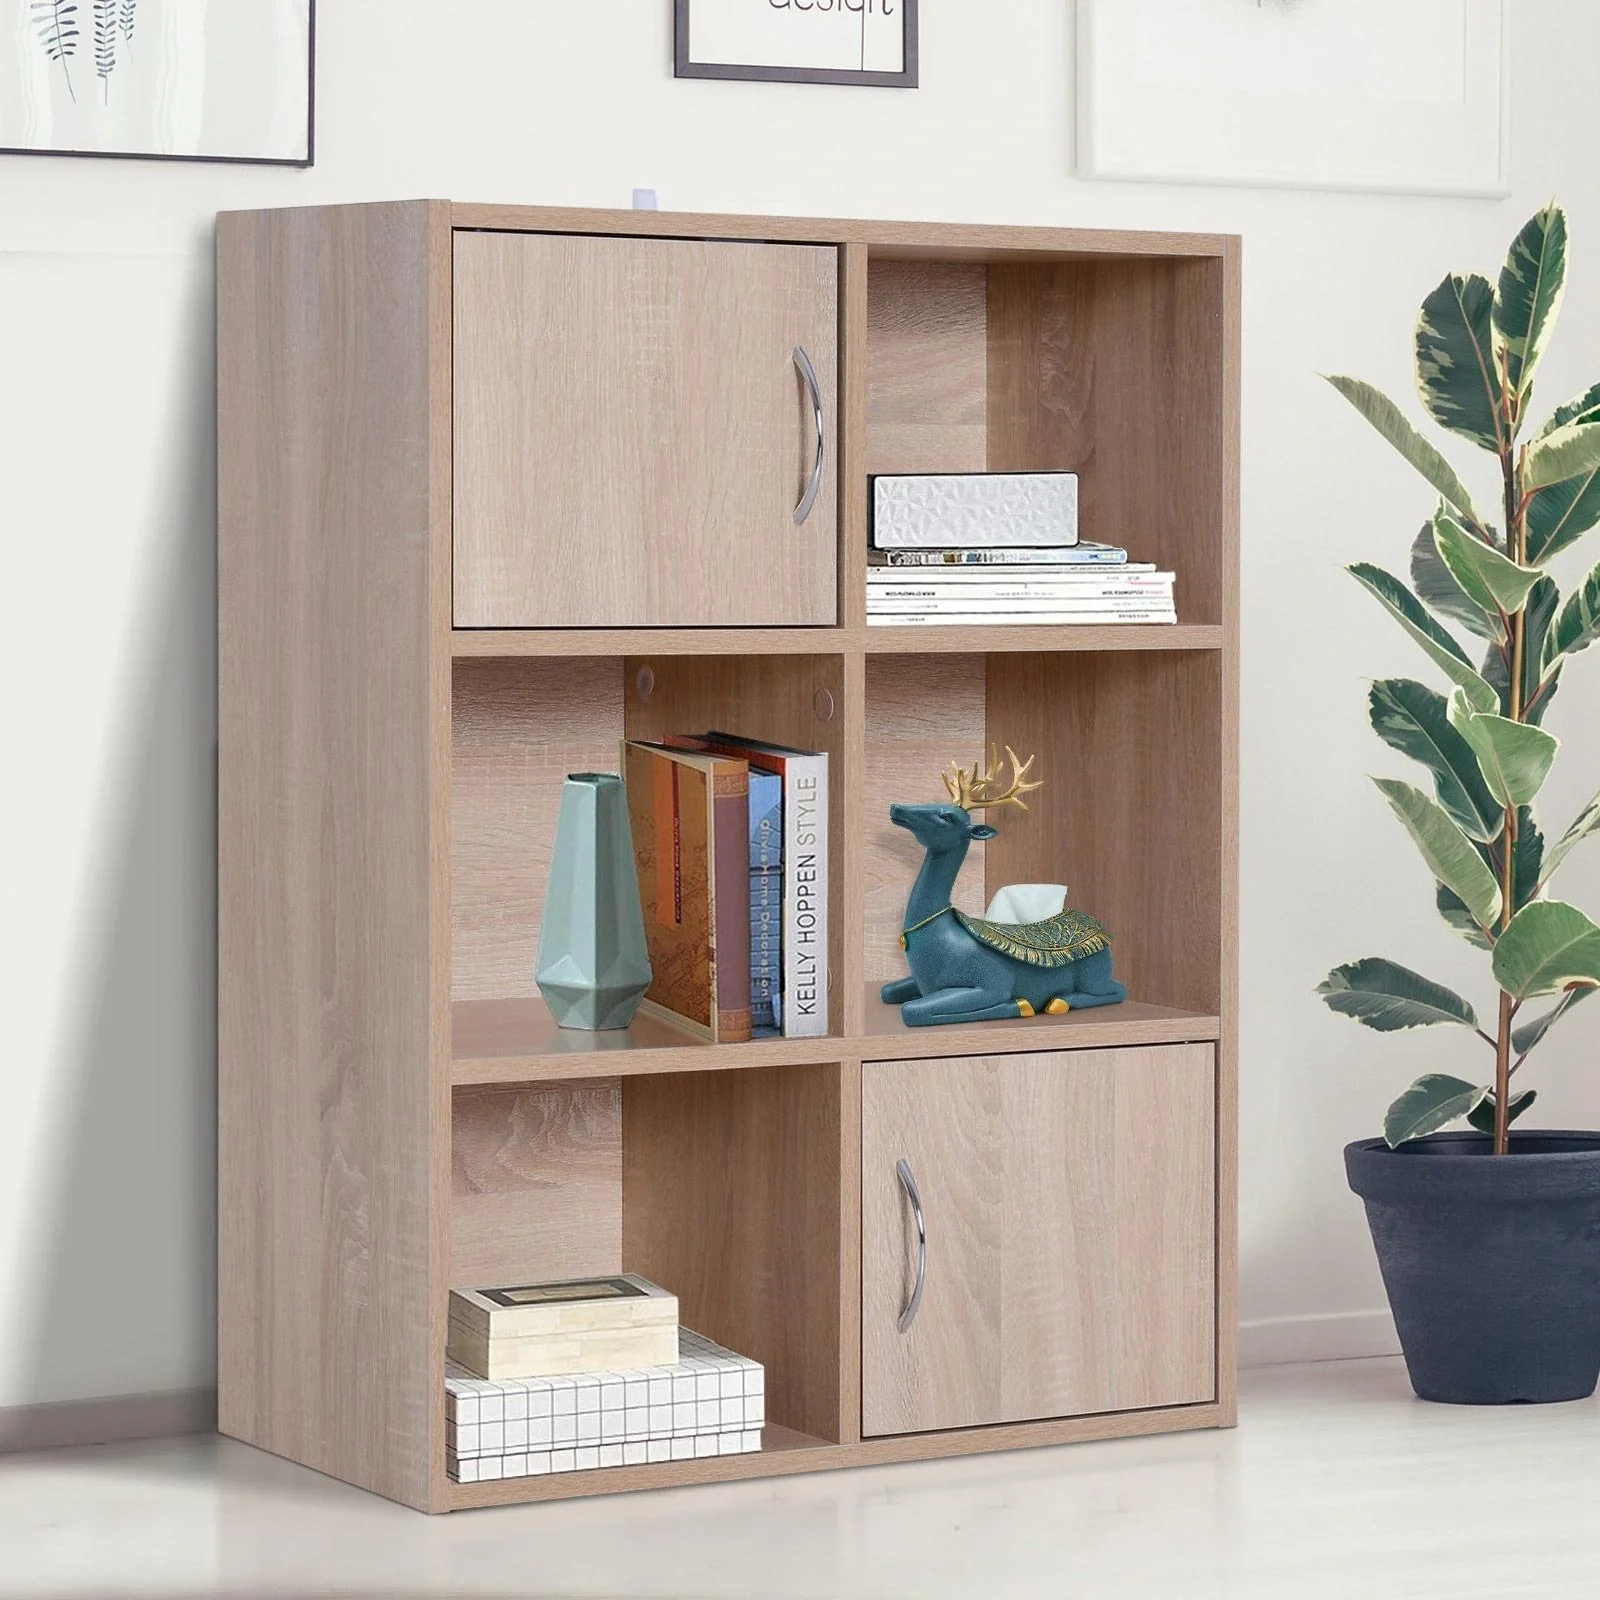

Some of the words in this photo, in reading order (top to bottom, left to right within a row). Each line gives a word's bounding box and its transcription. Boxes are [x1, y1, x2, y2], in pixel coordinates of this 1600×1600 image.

[796, 777, 817, 846] STYLE
[796, 854, 817, 944] HOPPEN
[796, 952, 816, 1016] KELLY
